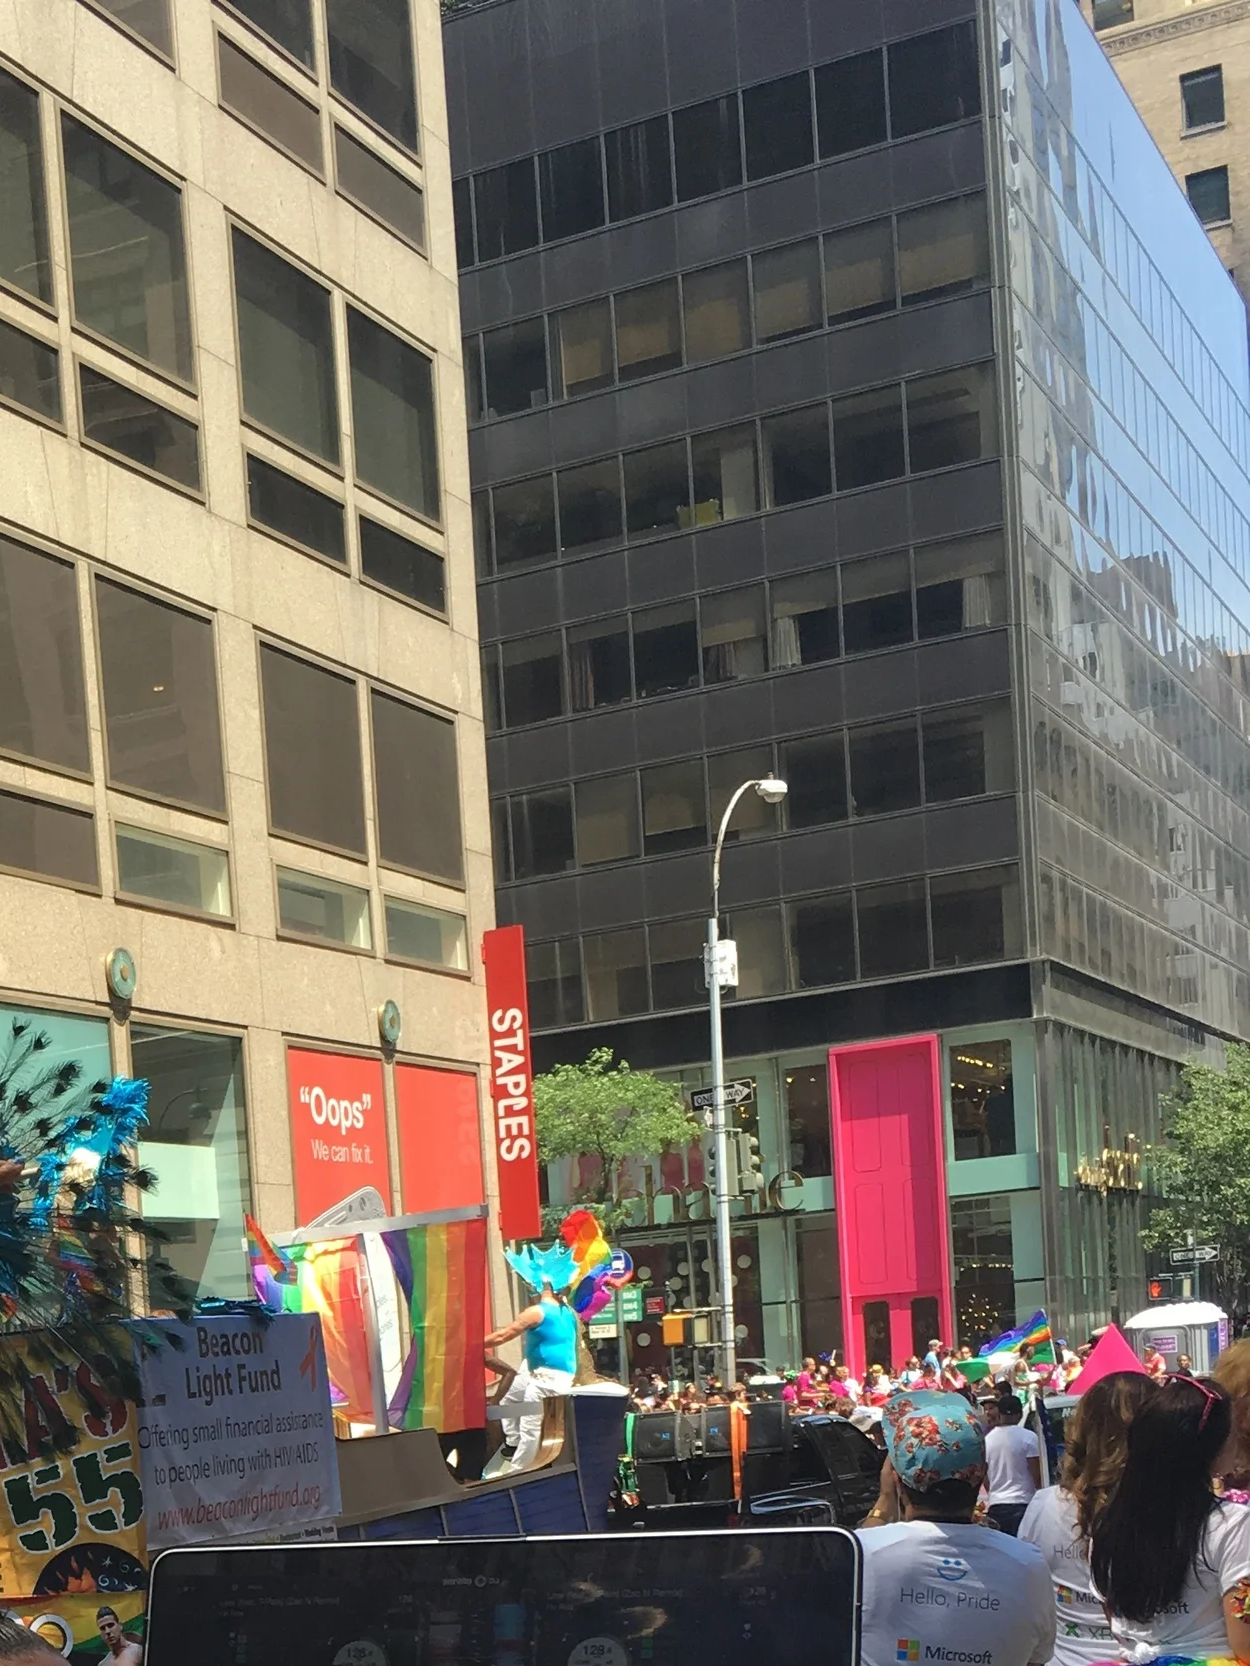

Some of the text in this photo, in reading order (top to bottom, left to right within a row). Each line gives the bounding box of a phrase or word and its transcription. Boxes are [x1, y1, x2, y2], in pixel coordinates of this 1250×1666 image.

[492, 1007, 531, 1162] STAPLES
[726, 1088, 745, 1099] WAY
[311, 1139, 329, 1161] We
[331, 1145, 350, 1162] can
[351, 1142, 363, 1163] fix
[196, 1326, 265, 1358] Beacon
[185, 1360, 282, 1406] Light Fund
[137, 1411, 325, 1450] Offering small financial assistance
[154, 1466, 166, 1486] to
[168, 1462, 211, 1489] people
[212, 1455, 246, 1480] living
[247, 1448, 272, 1472] with
[3, 1440, 143, 1553] 55
[157, 1482, 322, 1530] www.beaconlightfund.org
[900, 1588, 1001, 1611] Hello, Pride
[925, 1646, 993, 1665] Microsoft
